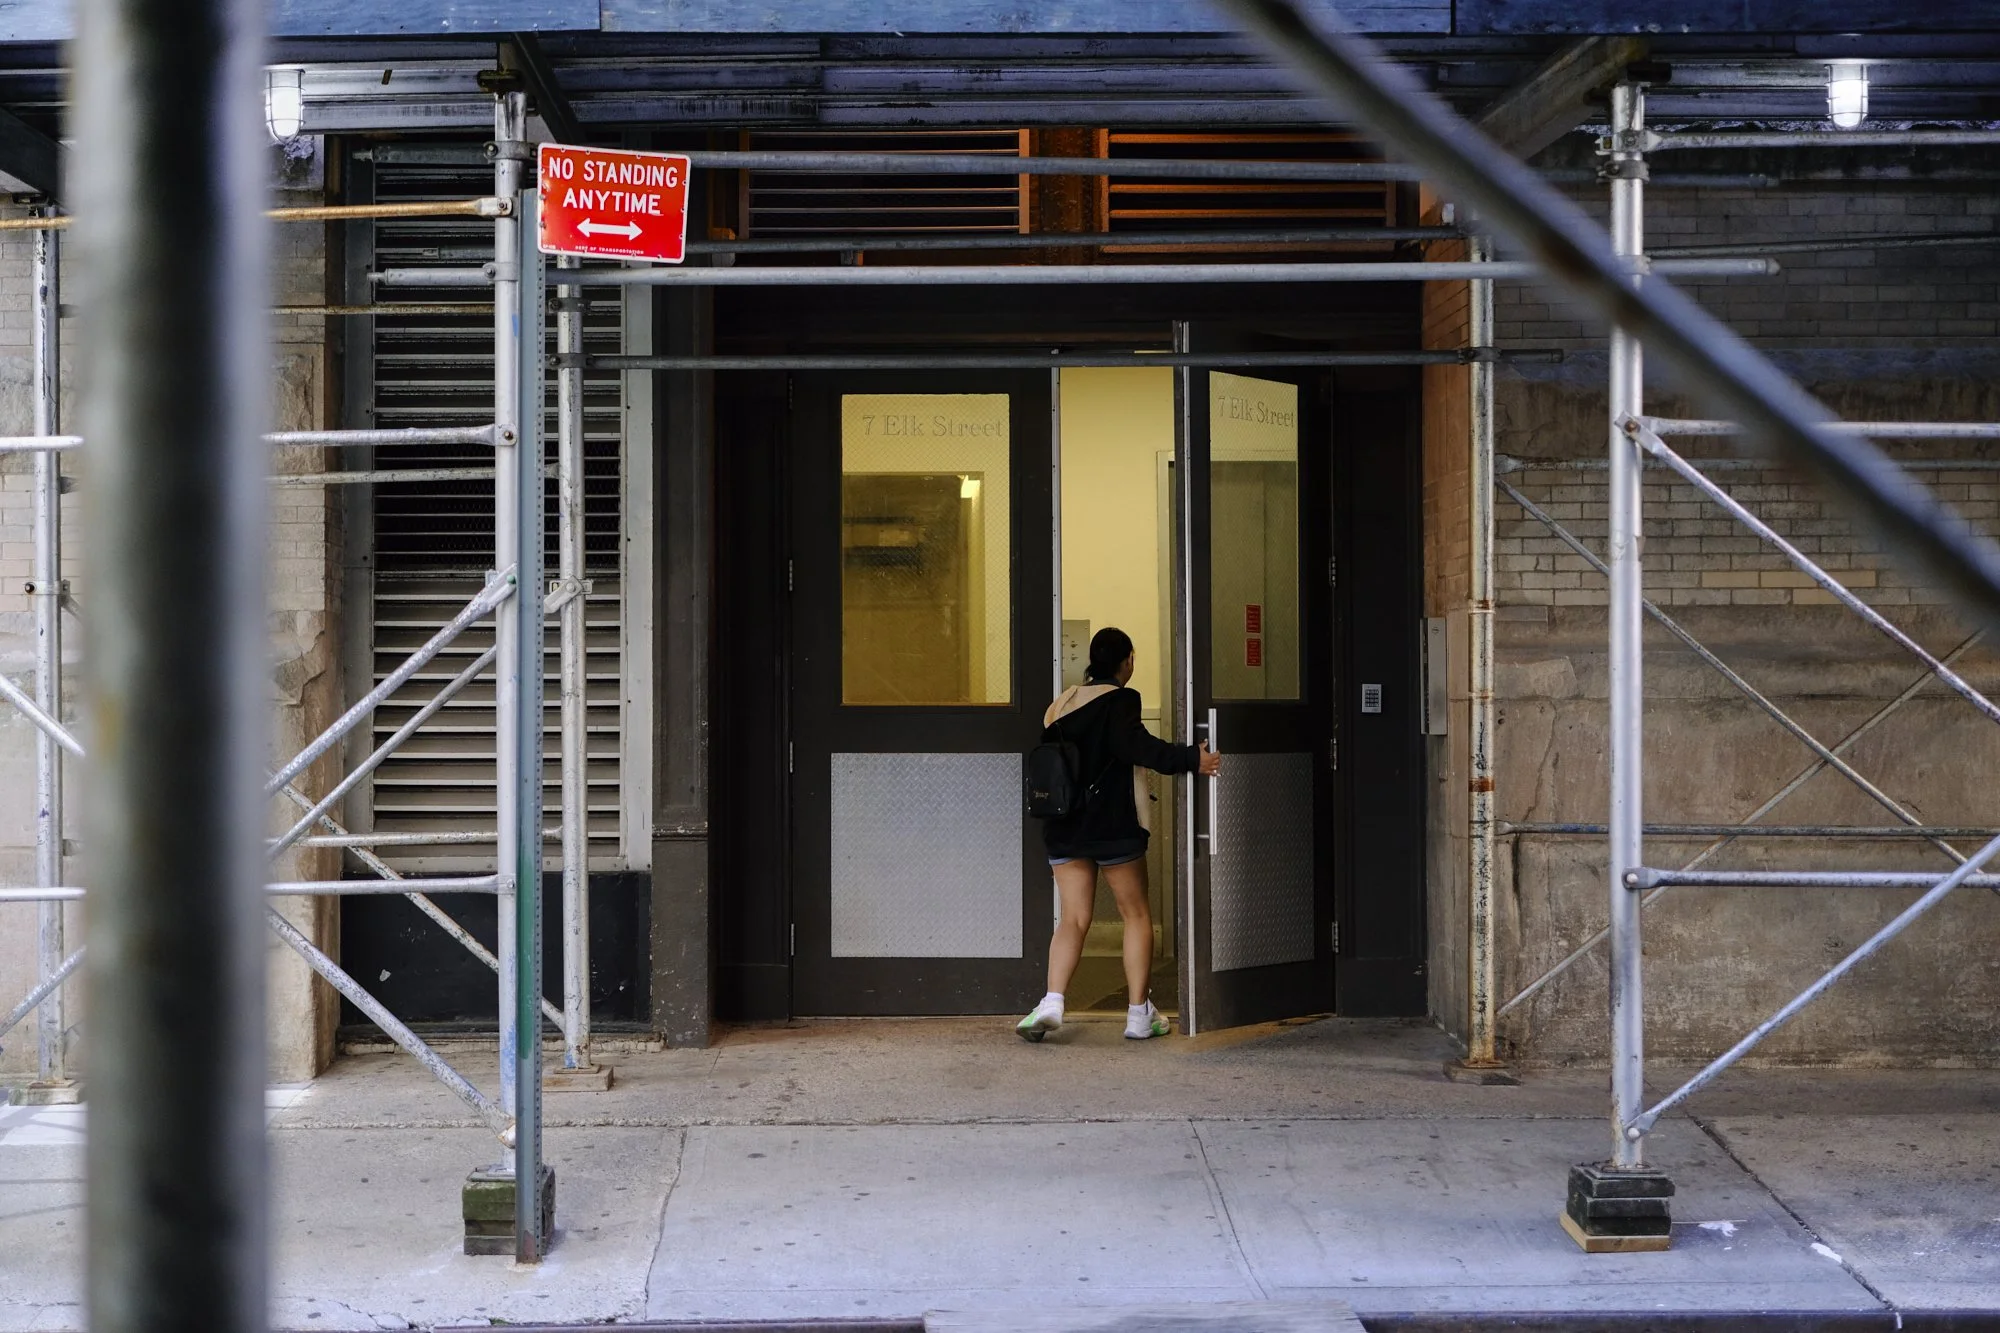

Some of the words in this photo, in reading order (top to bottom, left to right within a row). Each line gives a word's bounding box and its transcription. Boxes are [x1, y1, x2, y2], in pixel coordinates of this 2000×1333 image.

[549, 156, 574, 180] NO
[583, 159, 678, 188] STANDING
[562, 187, 661, 215] ANYTIME
[862, 415, 876, 436] 7
[882, 415, 925, 436] Elk
[932, 415, 1003, 437] Street
[1218, 396, 1226, 418] 7
[1229, 396, 1253, 421] Elk
[1257, 401, 1295, 429] Street
